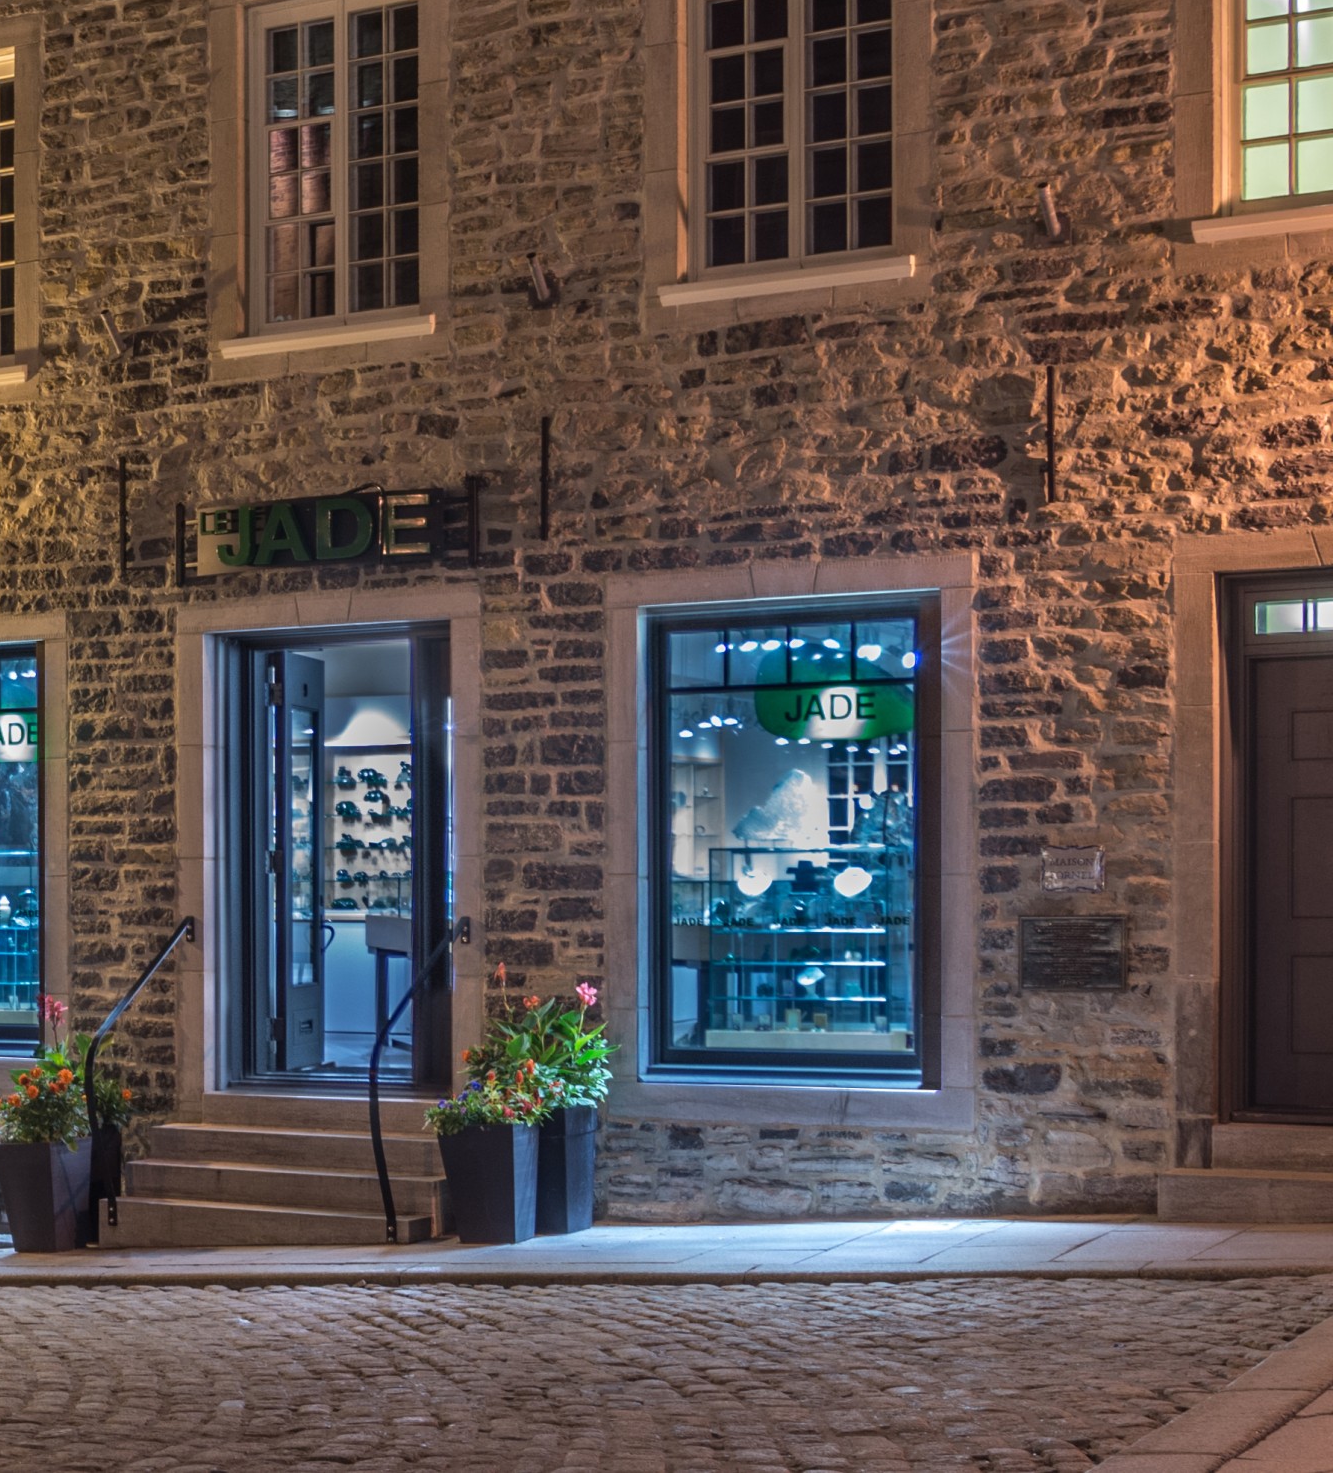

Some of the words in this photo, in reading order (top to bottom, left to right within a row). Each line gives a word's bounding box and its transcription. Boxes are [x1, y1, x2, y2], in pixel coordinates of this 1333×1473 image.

[217, 494, 430, 566] JADE
[785, 692, 876, 722] JADE
[1050, 857, 1094, 866] MAISON
[673, 917, 703, 926] JADE
